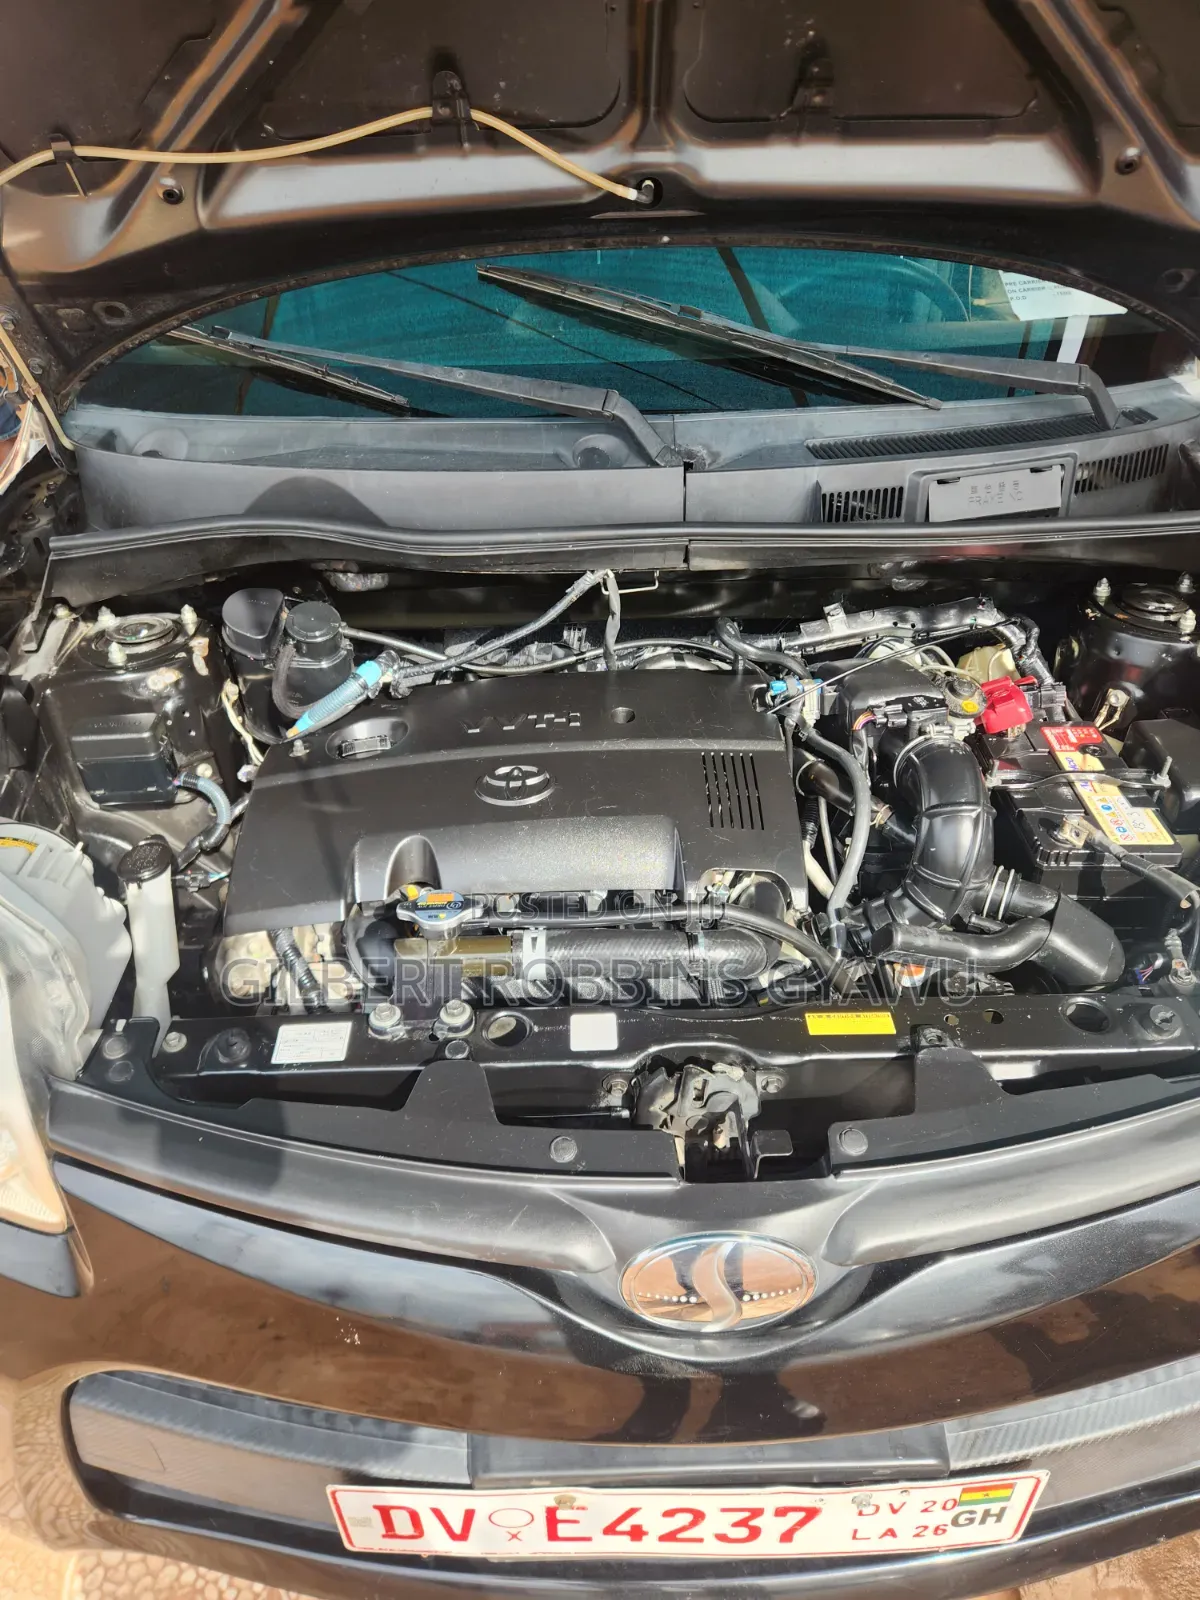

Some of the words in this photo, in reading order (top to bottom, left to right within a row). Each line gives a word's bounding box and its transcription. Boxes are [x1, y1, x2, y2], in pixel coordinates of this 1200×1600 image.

[857, 1501, 907, 1517] DV
[920, 1498, 958, 1514] 20
[950, 1506, 1008, 1528] GH
[372, 1504, 476, 1542] DV
[851, 1527, 899, 1541] LA
[912, 1524, 949, 1538] 26
